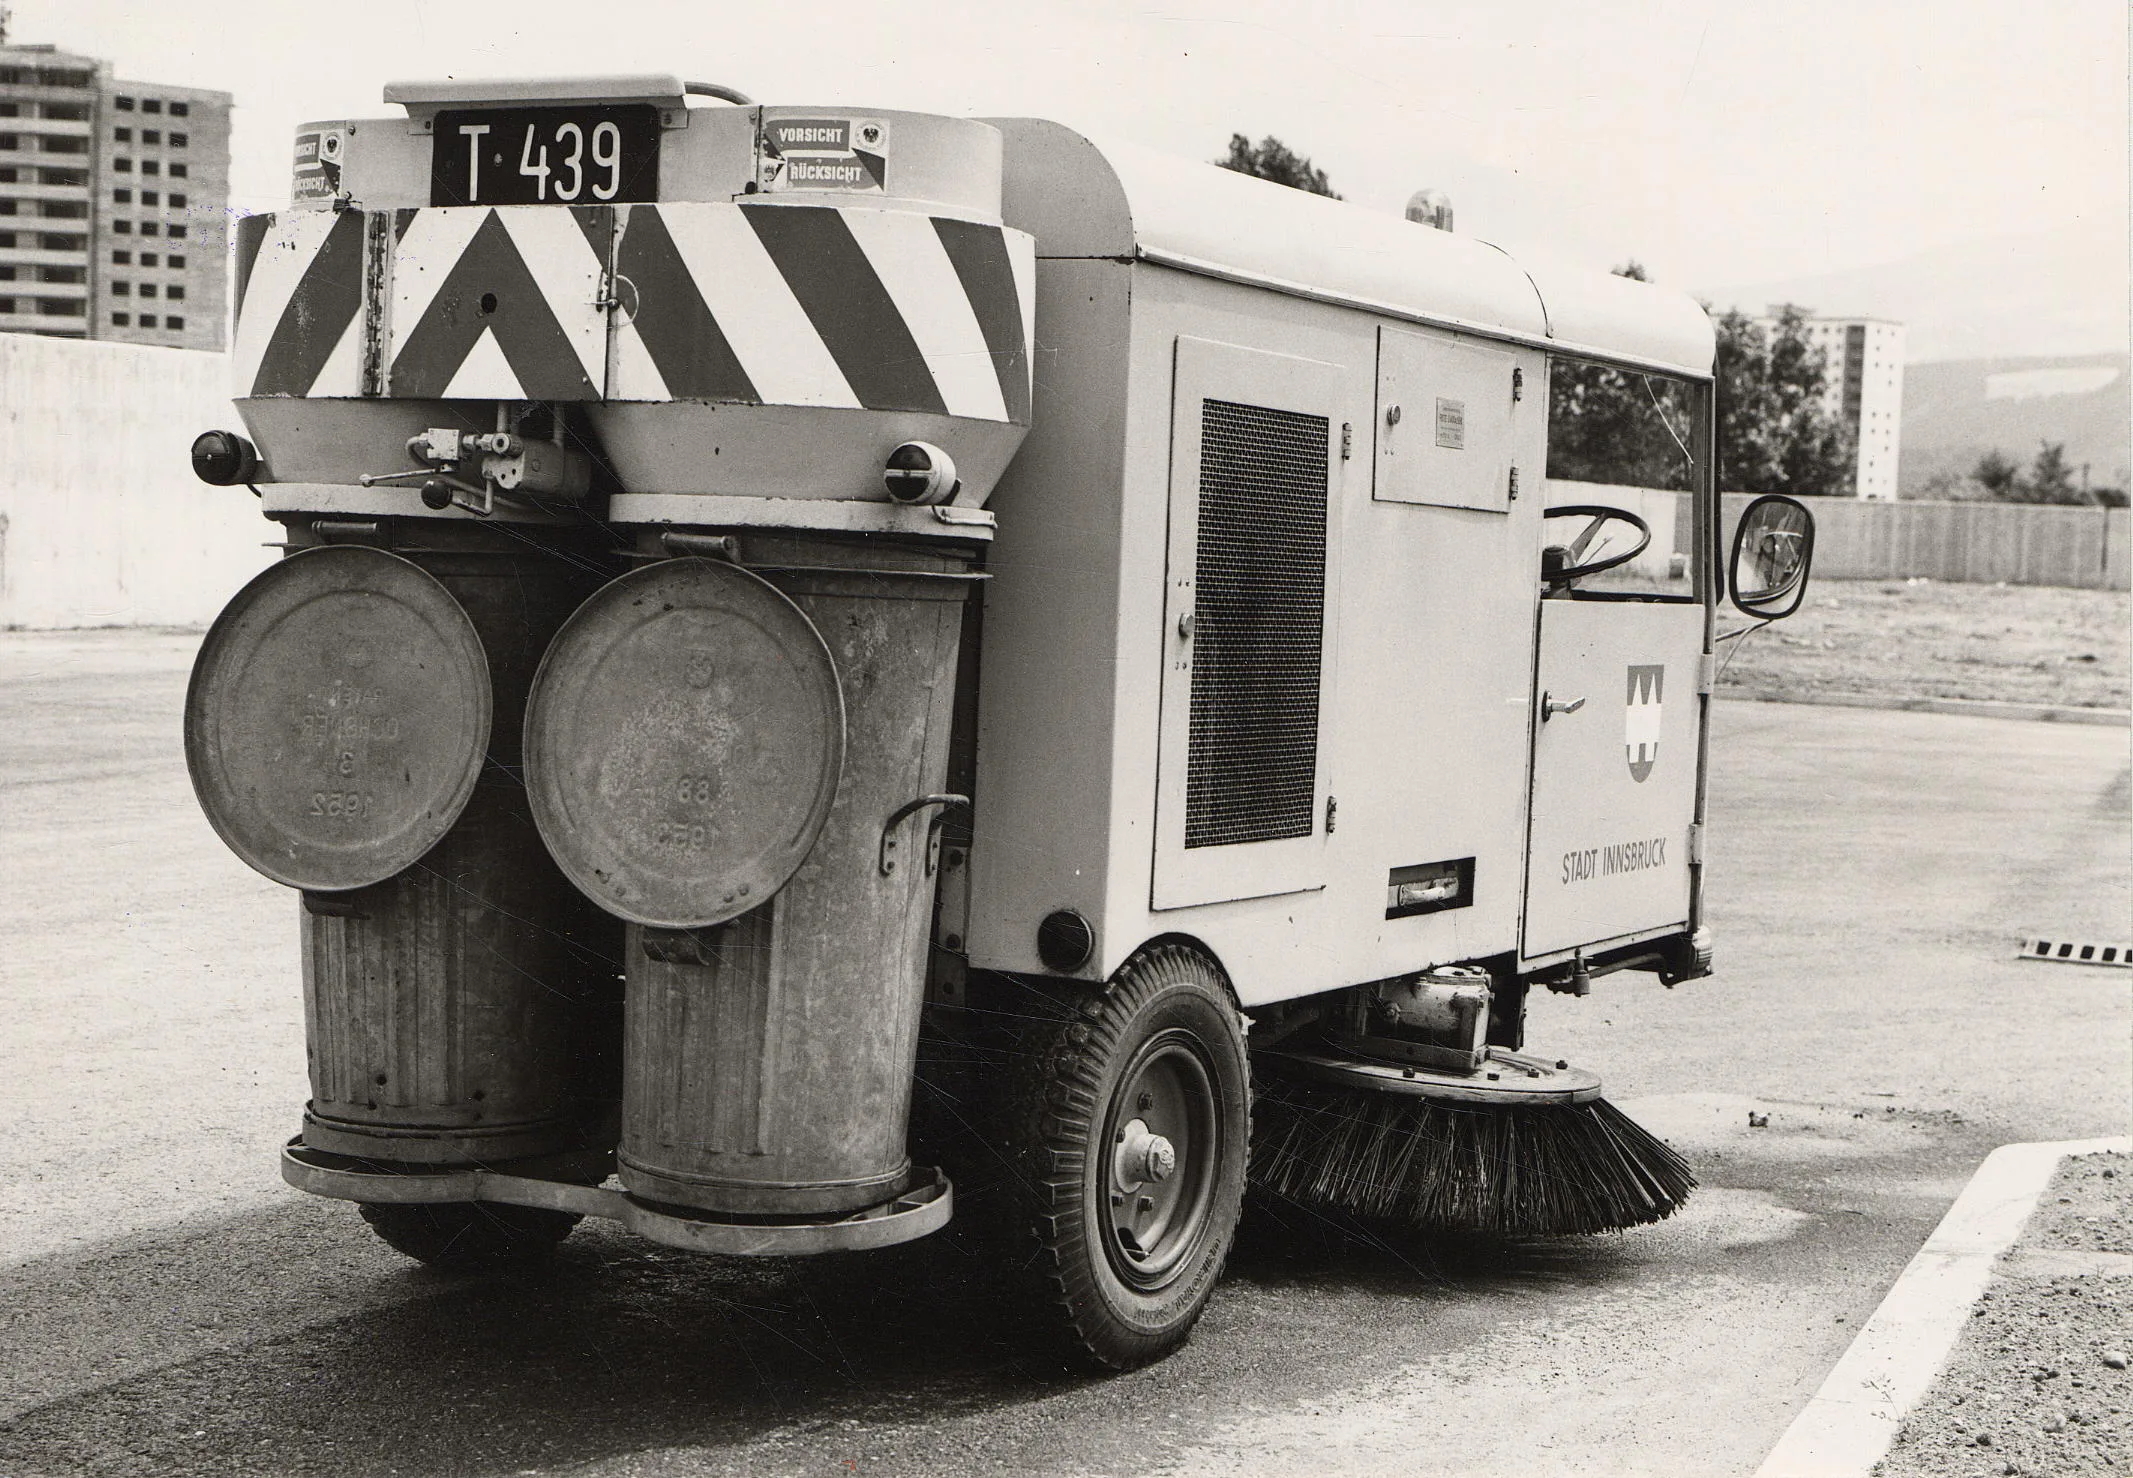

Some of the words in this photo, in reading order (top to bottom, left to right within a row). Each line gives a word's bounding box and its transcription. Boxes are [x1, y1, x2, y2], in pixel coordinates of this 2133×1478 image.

[778, 127, 843, 144] VORSICHT
[459, 124, 491, 202] T
[519, 121, 621, 201] 439
[790, 162, 862, 182] RÜCKSICHT
[1562, 848, 1598, 885] STADT
[1602, 837, 1666, 876] INNSBRUCK
